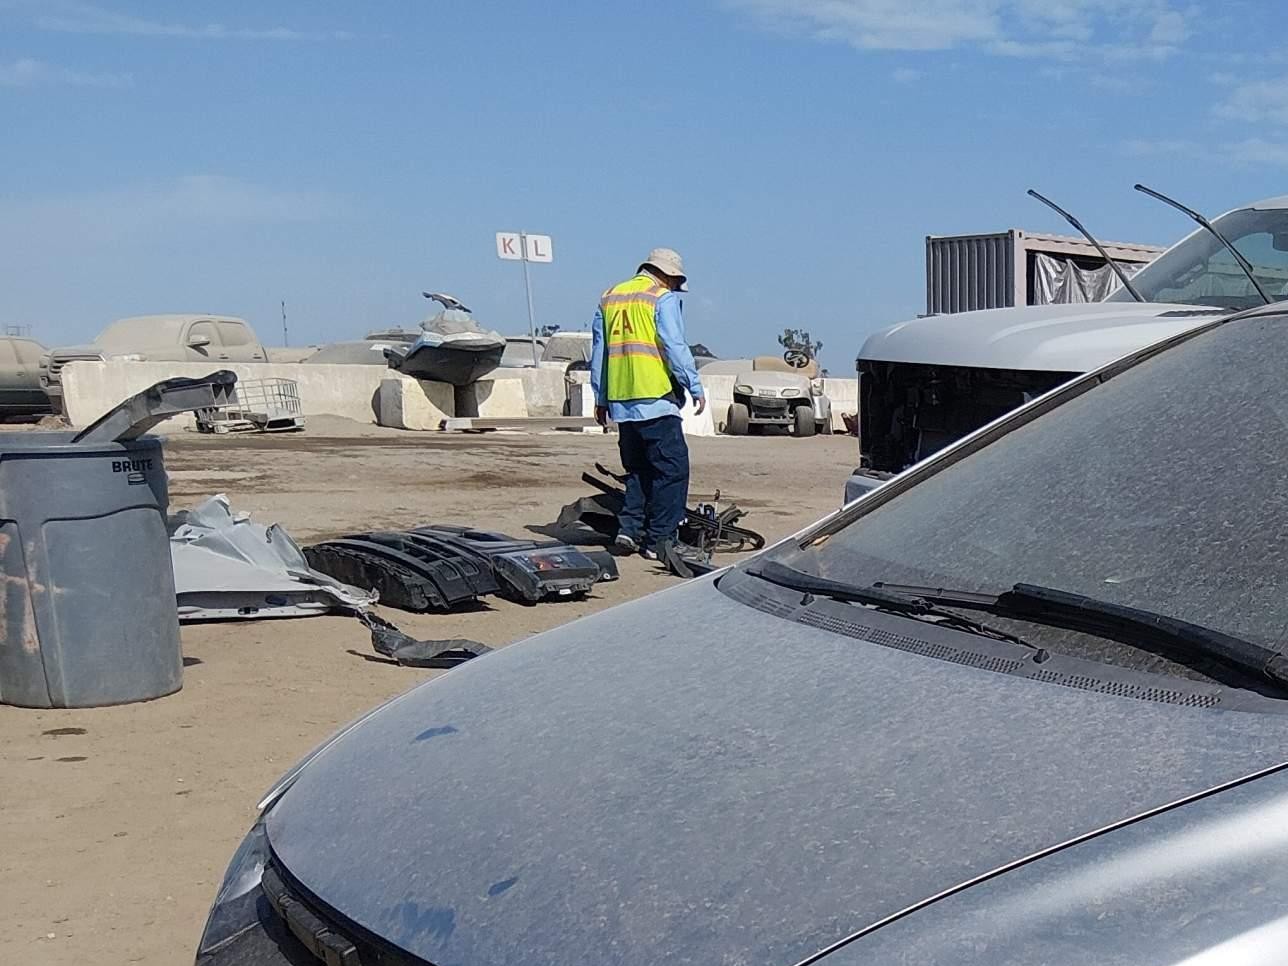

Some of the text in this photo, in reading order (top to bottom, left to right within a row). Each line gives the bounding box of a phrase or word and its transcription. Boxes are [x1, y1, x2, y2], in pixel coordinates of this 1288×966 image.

[502, 237, 515, 254] K
[534, 239, 546, 256] L
[112, 459, 152, 472] BRUTE
